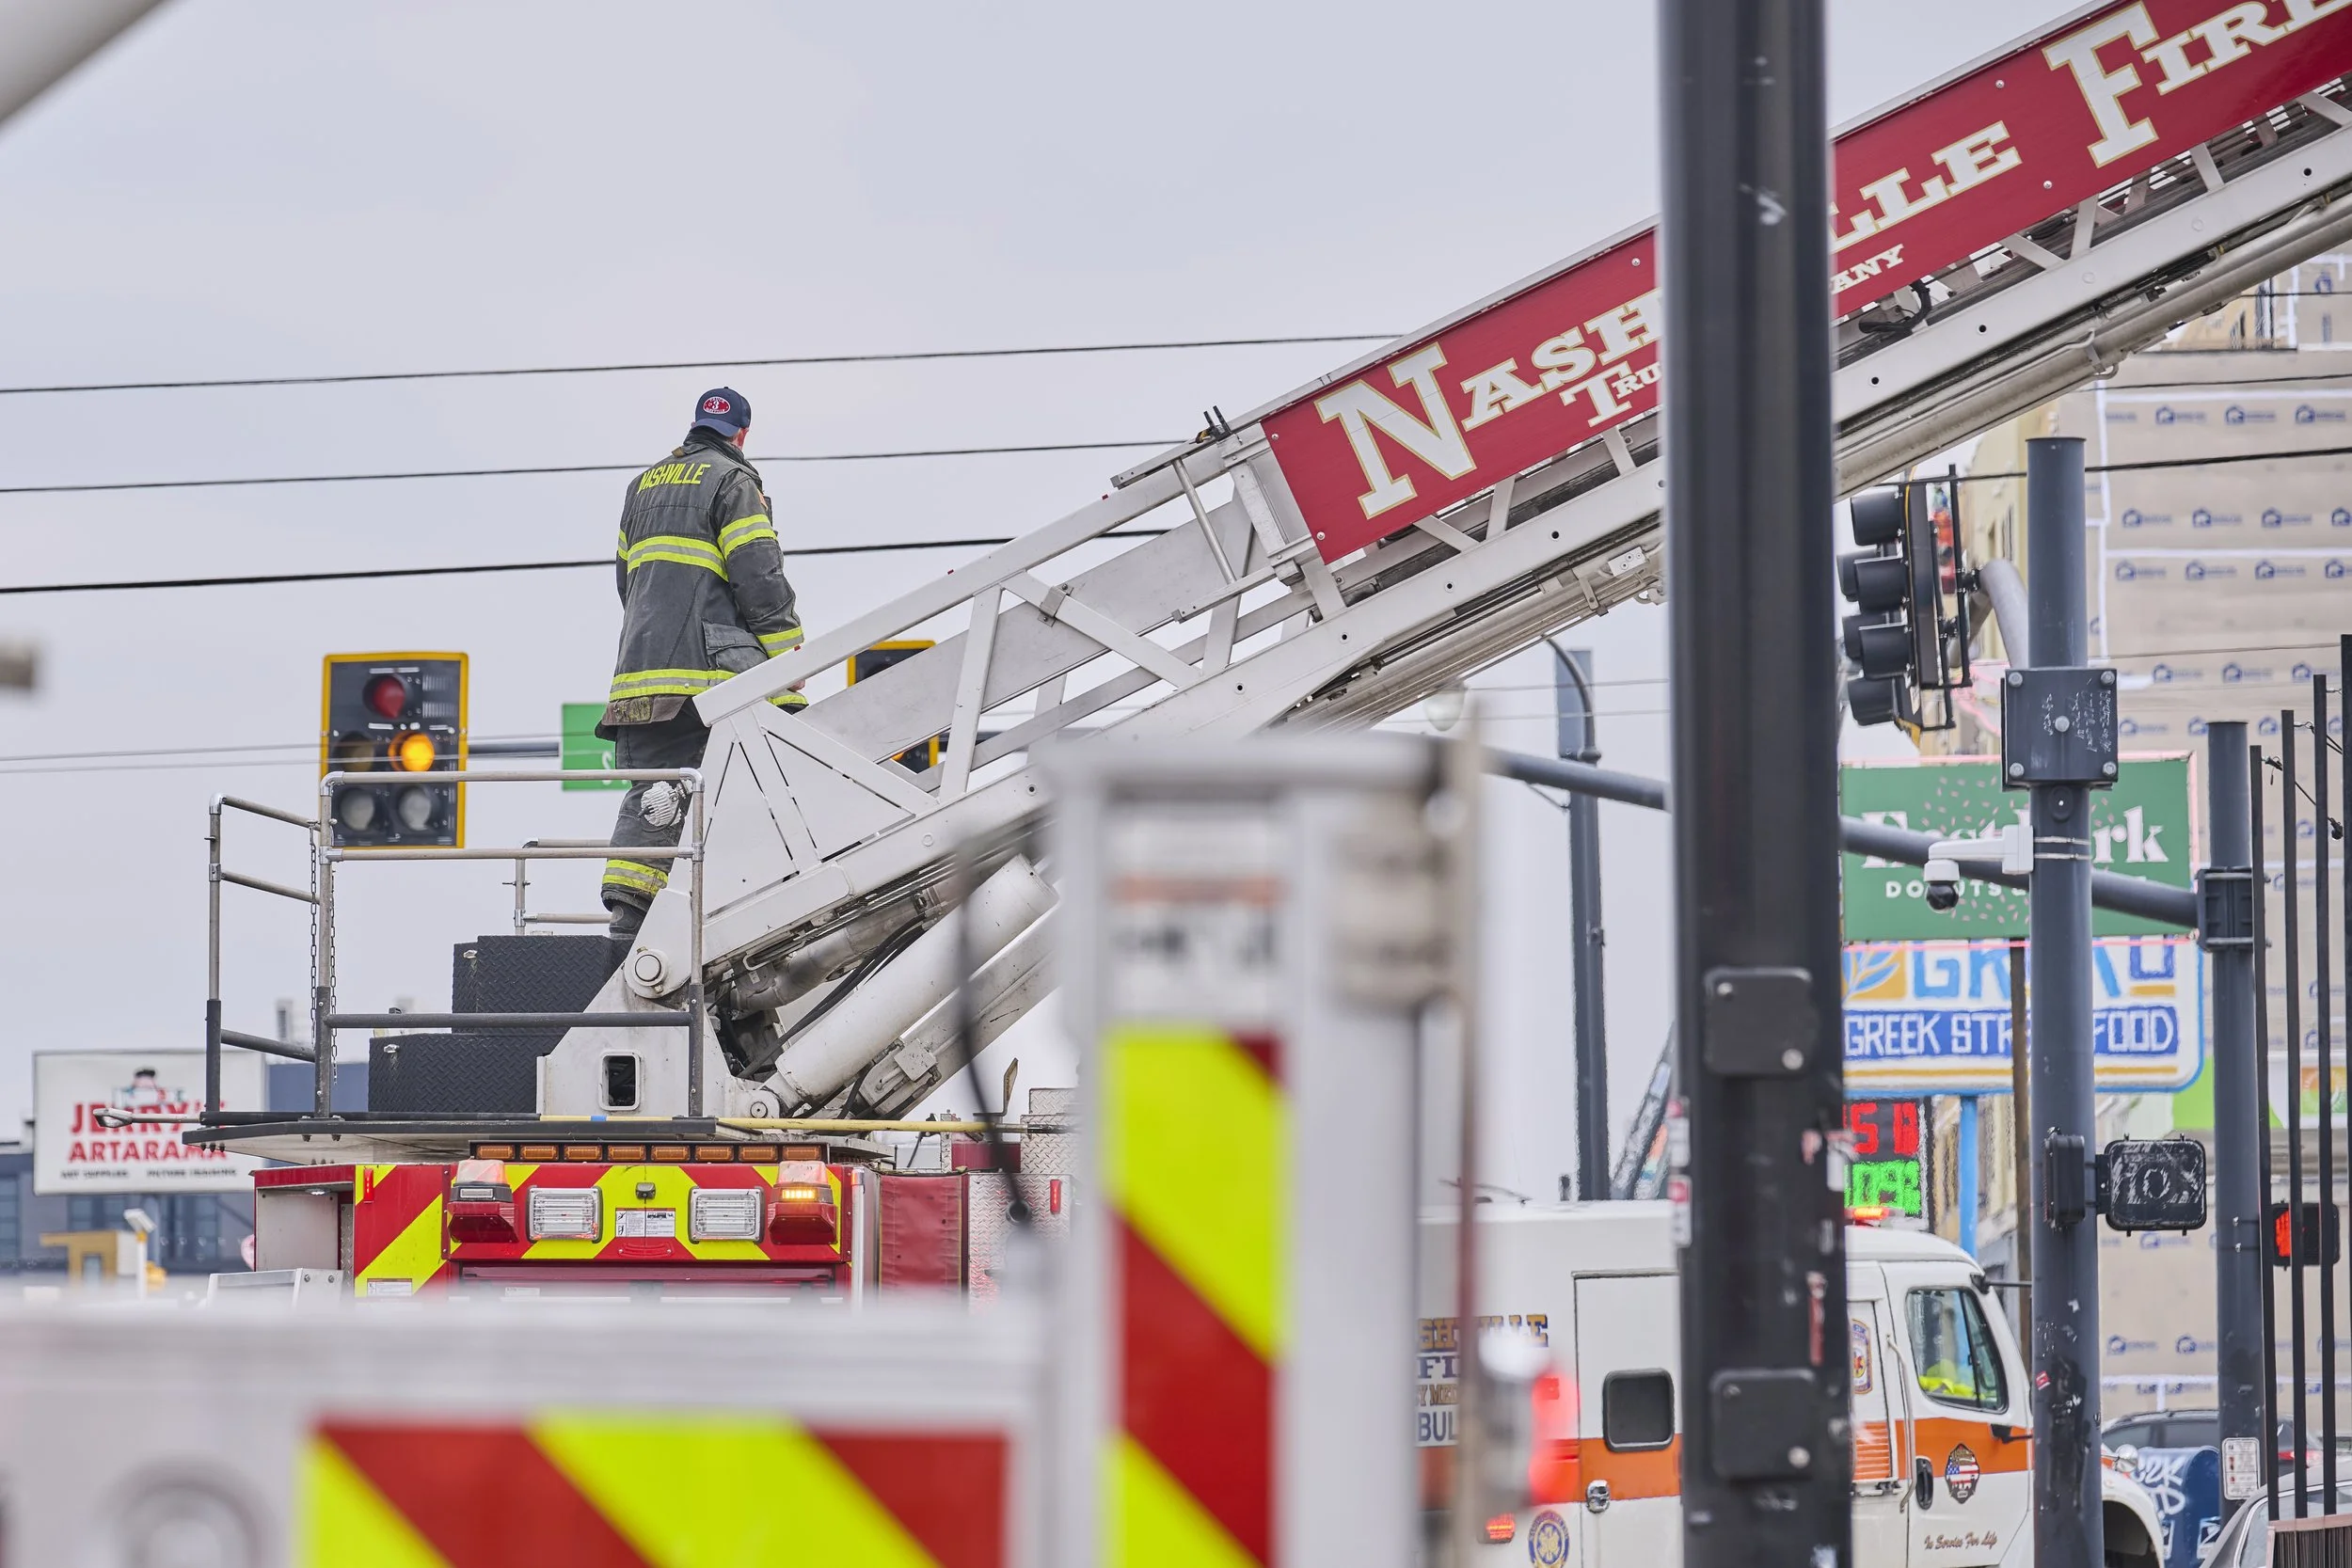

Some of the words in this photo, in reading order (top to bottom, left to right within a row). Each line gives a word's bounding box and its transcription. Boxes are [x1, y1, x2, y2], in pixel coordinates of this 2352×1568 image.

[1559, 361, 1663, 428] TRU
[637, 464, 711, 494] NASHVILLE
[1844, 1013, 1941, 1056] GREEK
